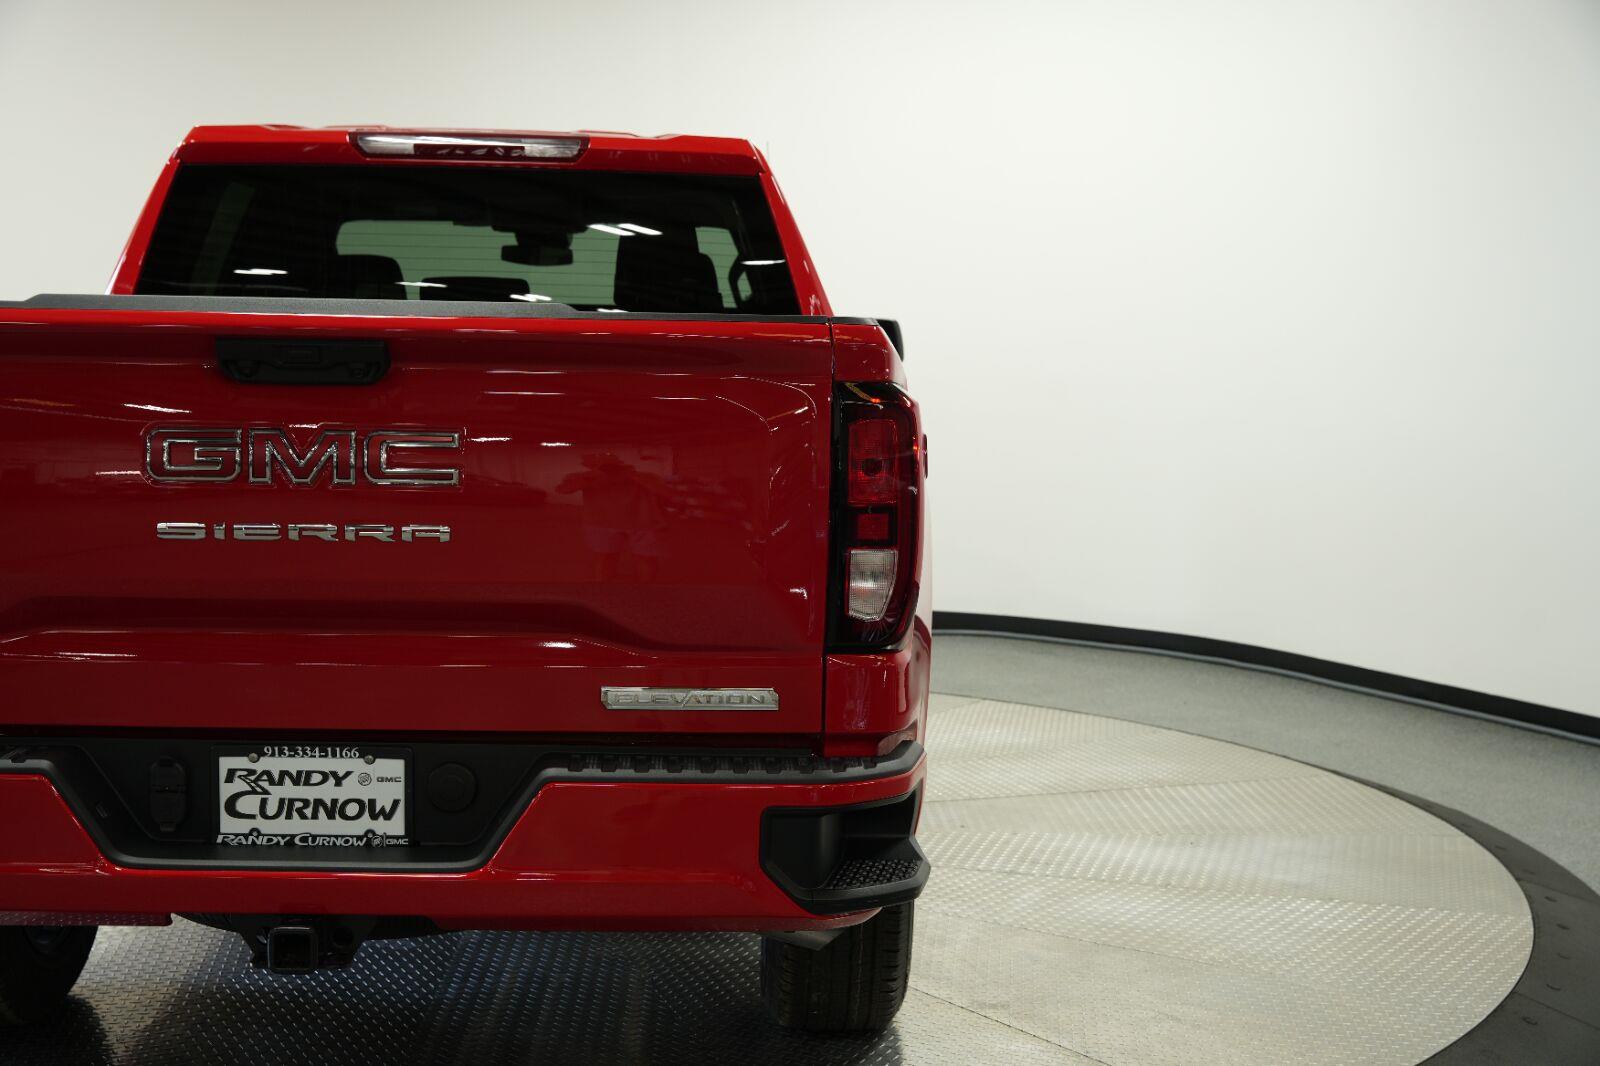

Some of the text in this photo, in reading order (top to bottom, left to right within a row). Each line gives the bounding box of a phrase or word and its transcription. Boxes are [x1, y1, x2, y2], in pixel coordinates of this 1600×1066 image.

[146, 427, 460, 486] GMC
[156, 521, 451, 543] SIERRA
[613, 691, 766, 706] ELEVATION
[264, 746, 360, 759] 913-334-1166
[223, 768, 355, 789] RANDY
[224, 790, 401, 821] CURNOW
[216, 834, 291, 846] RANDY
[294, 833, 367, 847] CURNOW
